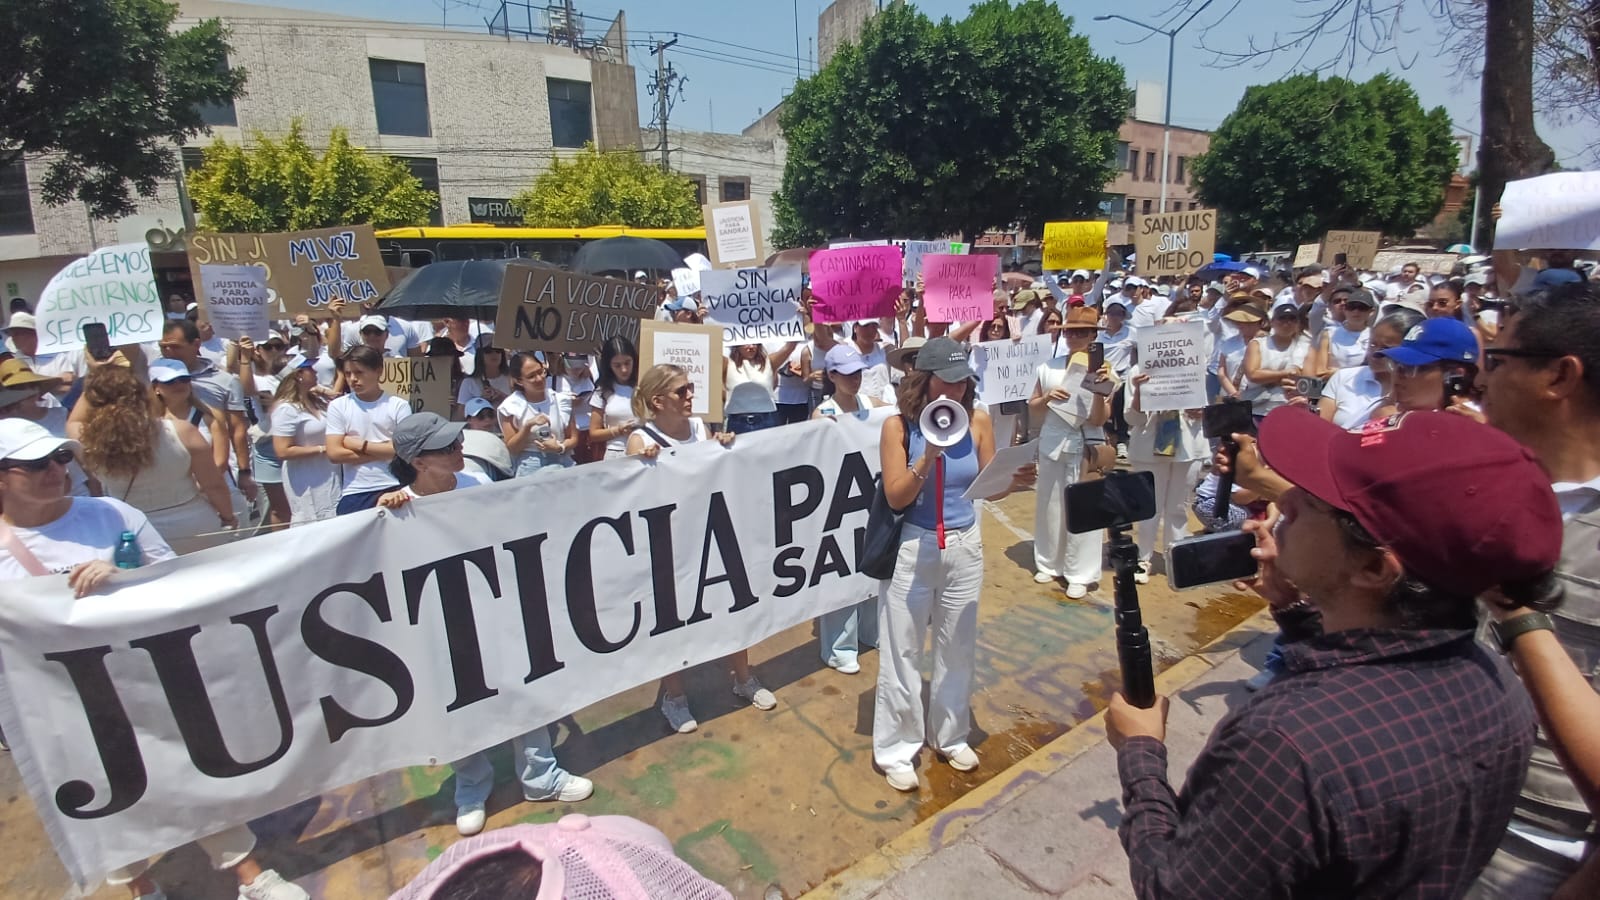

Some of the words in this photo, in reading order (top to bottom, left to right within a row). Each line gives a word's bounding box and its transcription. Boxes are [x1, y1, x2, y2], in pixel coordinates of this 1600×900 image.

[1141, 216, 1174, 235] SAN
[1178, 213, 1212, 231] LUIS
[192, 236, 237, 264] SIN
[289, 238, 319, 266] MI
[319, 231, 359, 260] VOZ
[1156, 231, 1188, 252] SIN
[820, 254, 886, 274] CAMINAMOS
[1146, 251, 1204, 270] MIEDO
[314, 262, 348, 283] PIDE
[735, 269, 768, 290] SIN
[938, 263, 977, 281] JUSTICIA
[45, 280, 157, 312] SENTIRNOS
[308, 278, 379, 306] JUSTICIA
[524, 271, 555, 304] LA
[567, 278, 658, 312] VIOLENCIA
[826, 279, 847, 296] POR
[871, 277, 891, 295] PAZ
[949, 285, 972, 299] PARA
[515, 305, 562, 341] NO
[566, 310, 588, 341] ES
[738, 306, 774, 325] CON
[938, 306, 983, 322] SANDRITA
[723, 321, 803, 342] ONCIENCIA
[984, 346, 999, 361] SIN
[1006, 342, 1040, 359] JUSTICIA
[1148, 339, 1194, 352] ¡JUSTICIA
[1157, 349, 1185, 358] PARA
[670, 356, 693, 364] PARA
[1144, 355, 1199, 370] SANDRA!
[378, 360, 437, 384] JUSTICIA
[997, 365, 1010, 380] NO
[1016, 361, 1034, 378] HAY
[396, 384, 421, 395] PARA
[1004, 383, 1027, 400] PAZ
[44, 490, 760, 820] JUSTICIA
